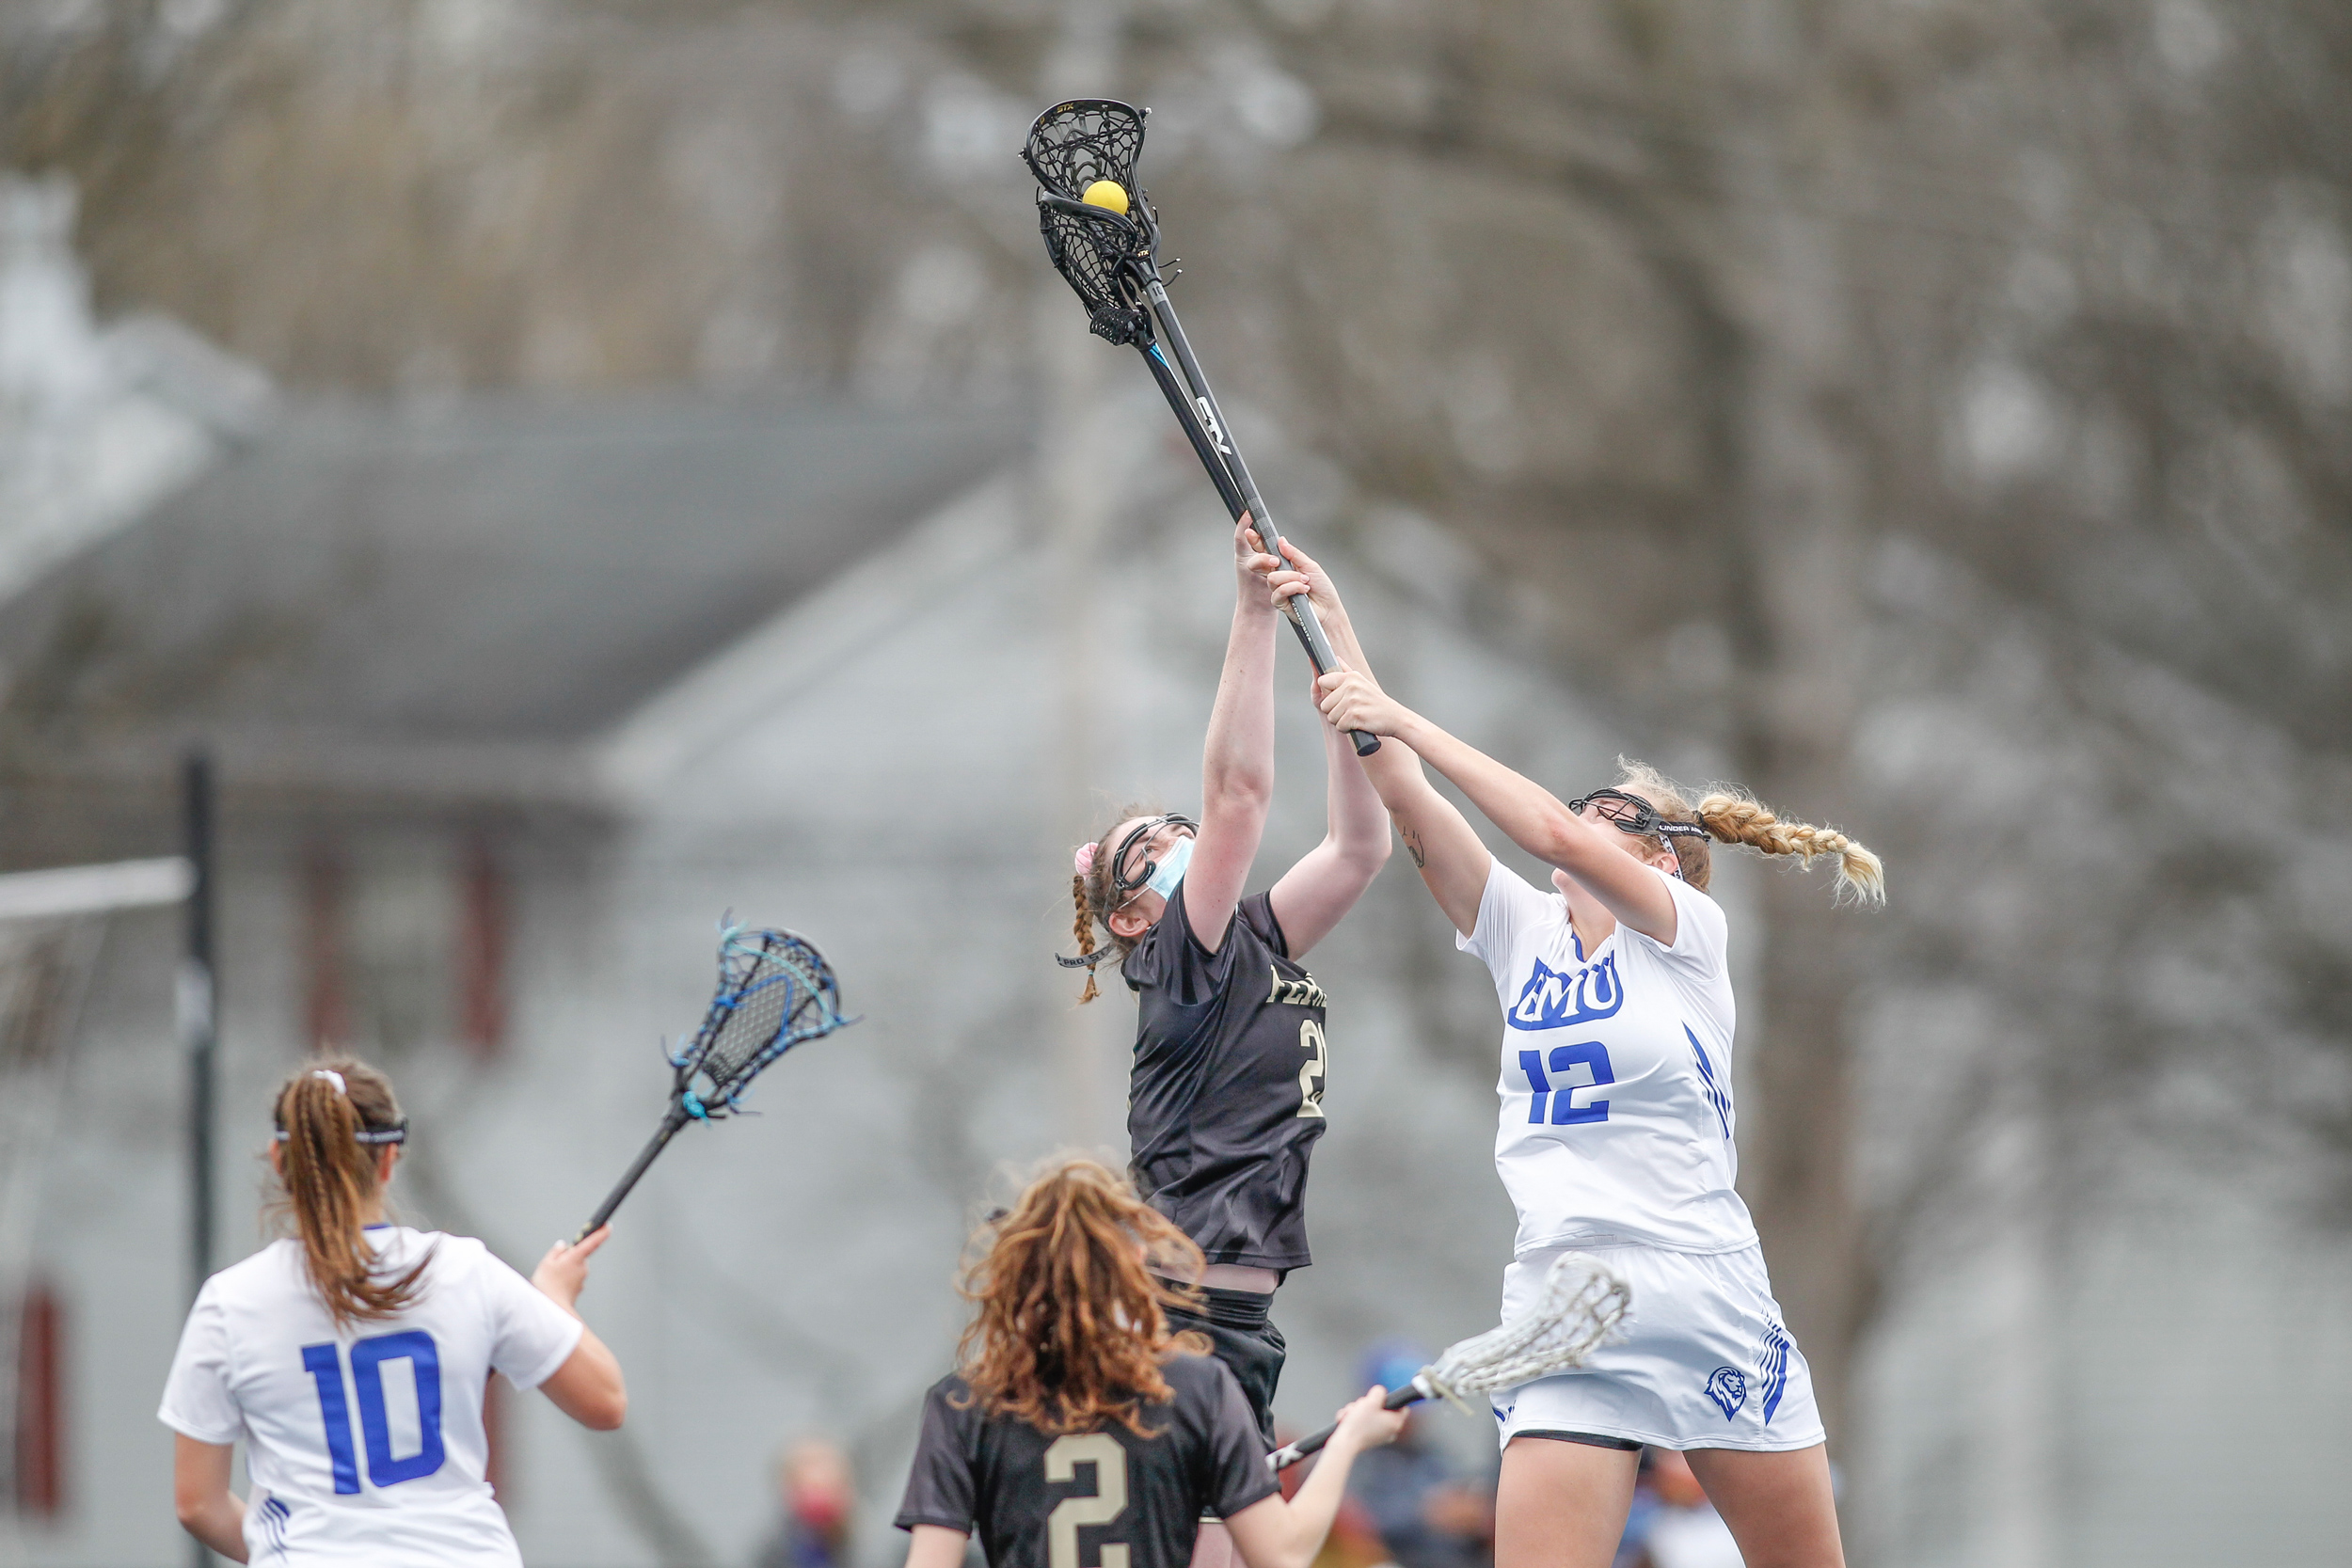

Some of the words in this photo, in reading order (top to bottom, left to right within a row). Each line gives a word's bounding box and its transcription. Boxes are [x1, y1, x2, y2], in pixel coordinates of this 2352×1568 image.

[1057, 103, 1074, 113] STX
[1292, 602, 1311, 641] COMPOSITE
[1658, 824, 1690, 832] UNDER
[1063, 958, 1085, 966] PRO
[1512, 953, 1619, 1027] EMU
[1518, 1040, 1615, 1125] 12
[301, 1330, 446, 1495] 10
[1044, 1432, 1131, 1568] 2
